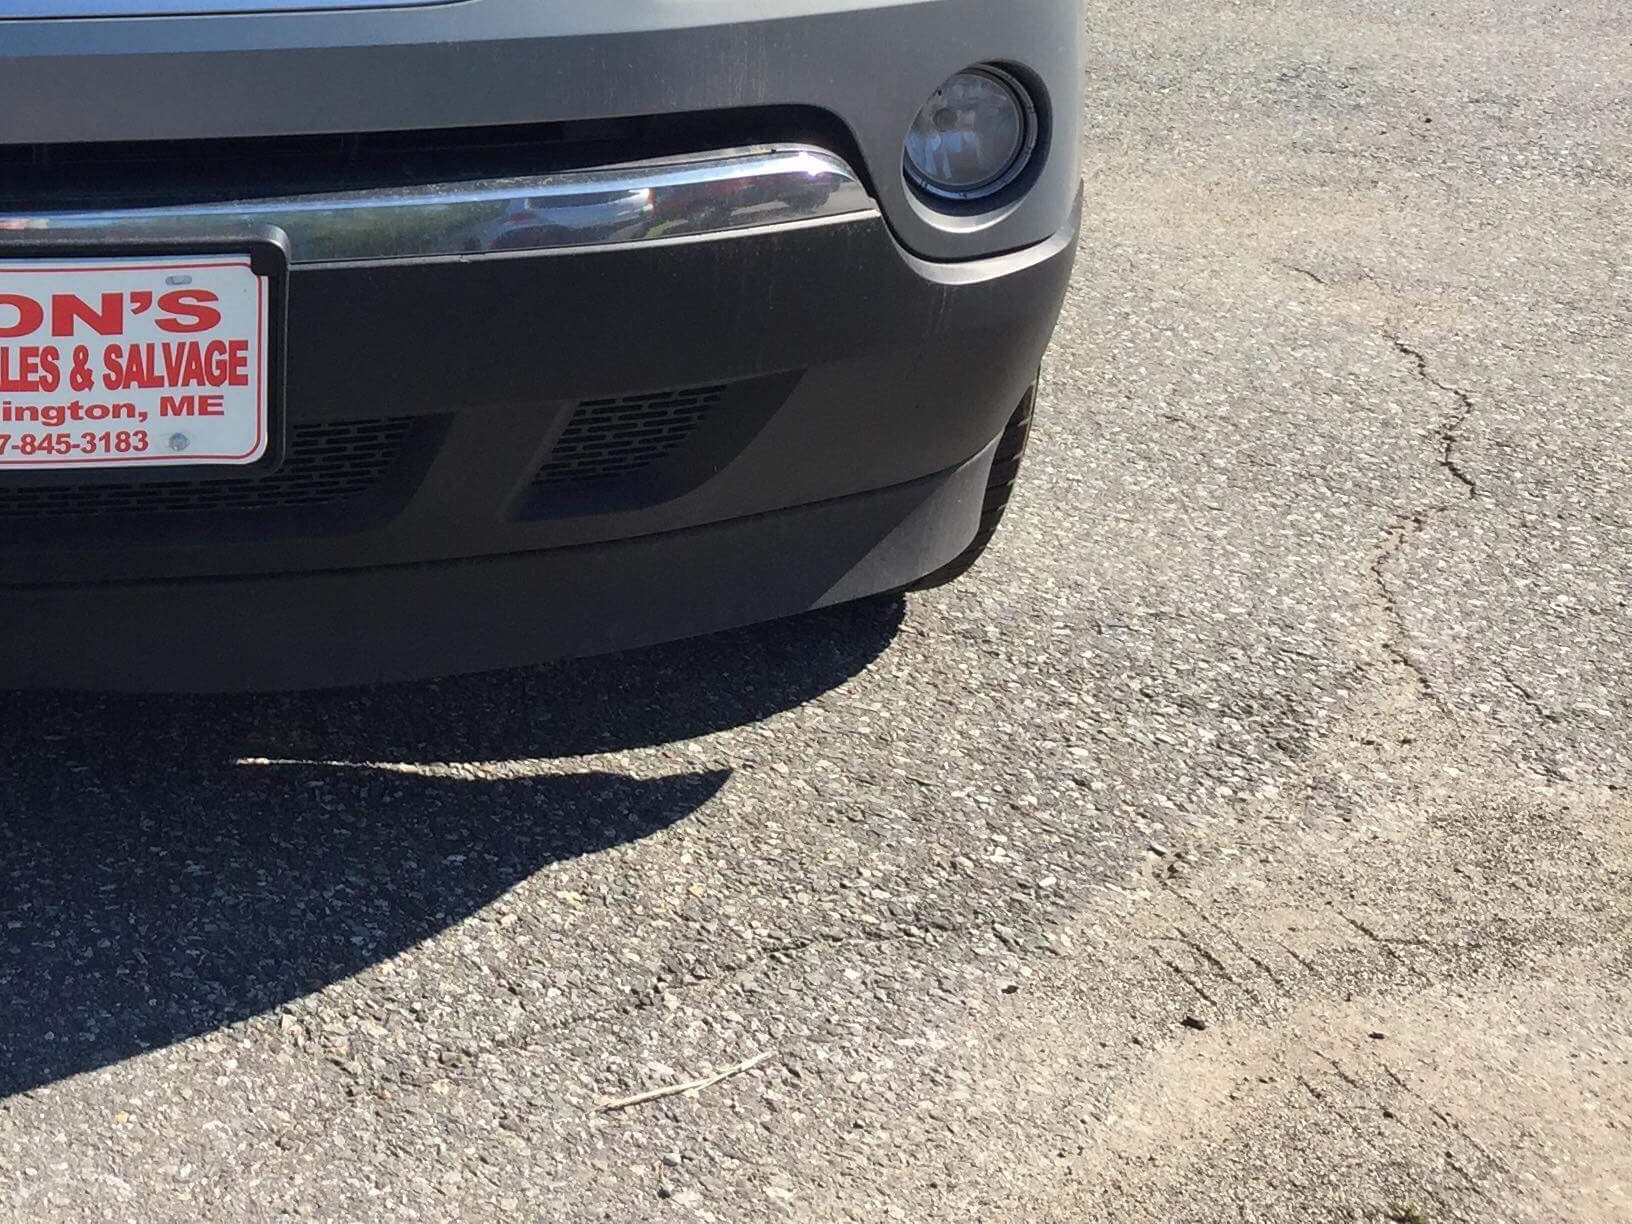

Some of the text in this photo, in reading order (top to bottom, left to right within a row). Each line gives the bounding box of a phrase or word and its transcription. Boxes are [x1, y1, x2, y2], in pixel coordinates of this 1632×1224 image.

[68, 345, 95, 392] &
[102, 339, 250, 389] SALVAGE
[159, 394, 225, 418] ME
